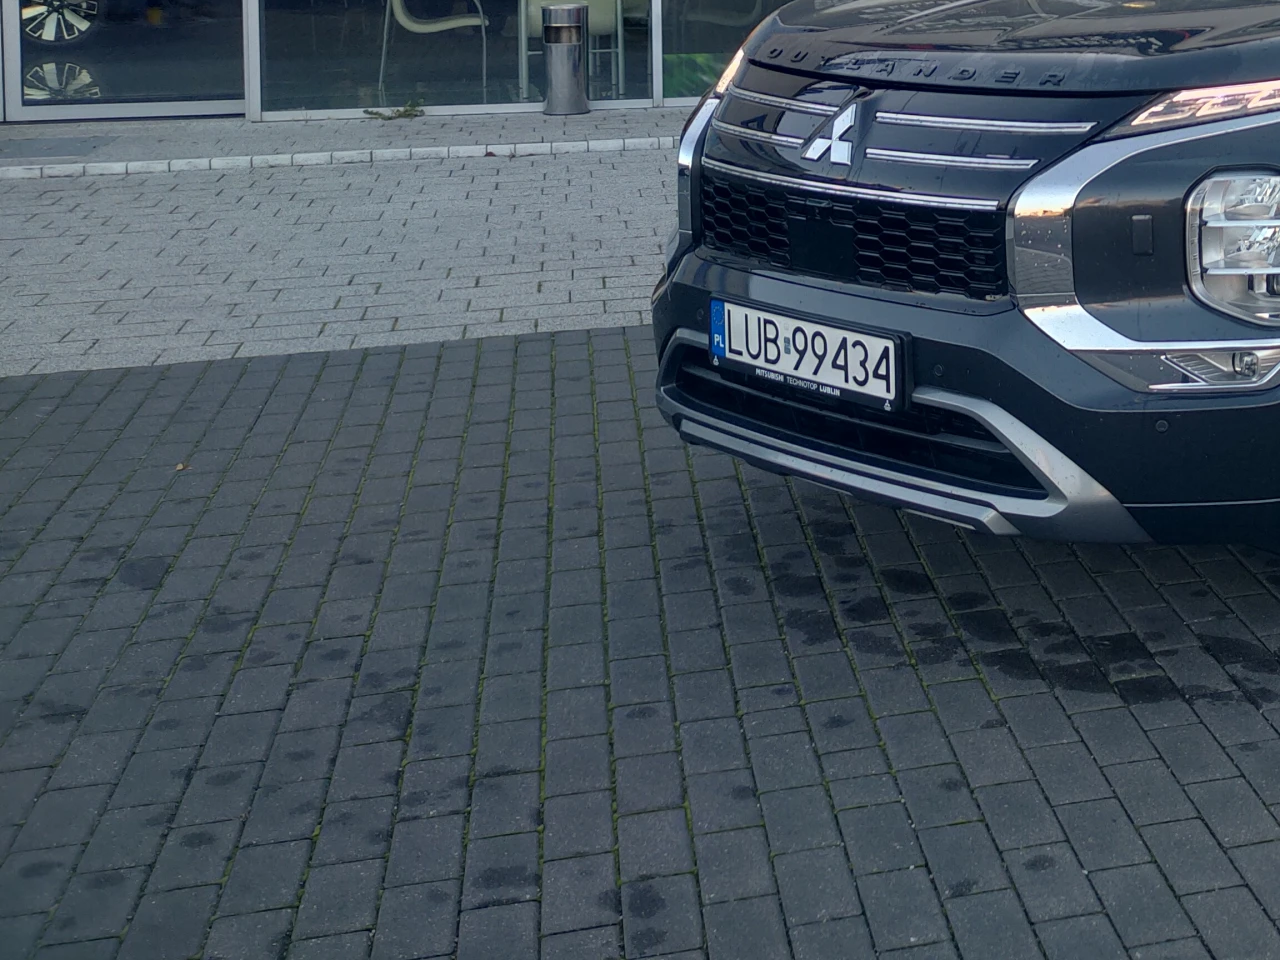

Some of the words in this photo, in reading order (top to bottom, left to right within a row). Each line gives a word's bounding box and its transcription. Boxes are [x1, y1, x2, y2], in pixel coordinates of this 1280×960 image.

[767, 47, 1066, 87] OUTLANDER
[713, 333, 725, 348] PL
[727, 308, 781, 365] LUB
[791, 325, 891, 394] 99434
[755, 367, 784, 383] MITSUBISHI
[786, 376, 818, 391] TECHNOTOP
[819, 385, 841, 397] LUBLIN
